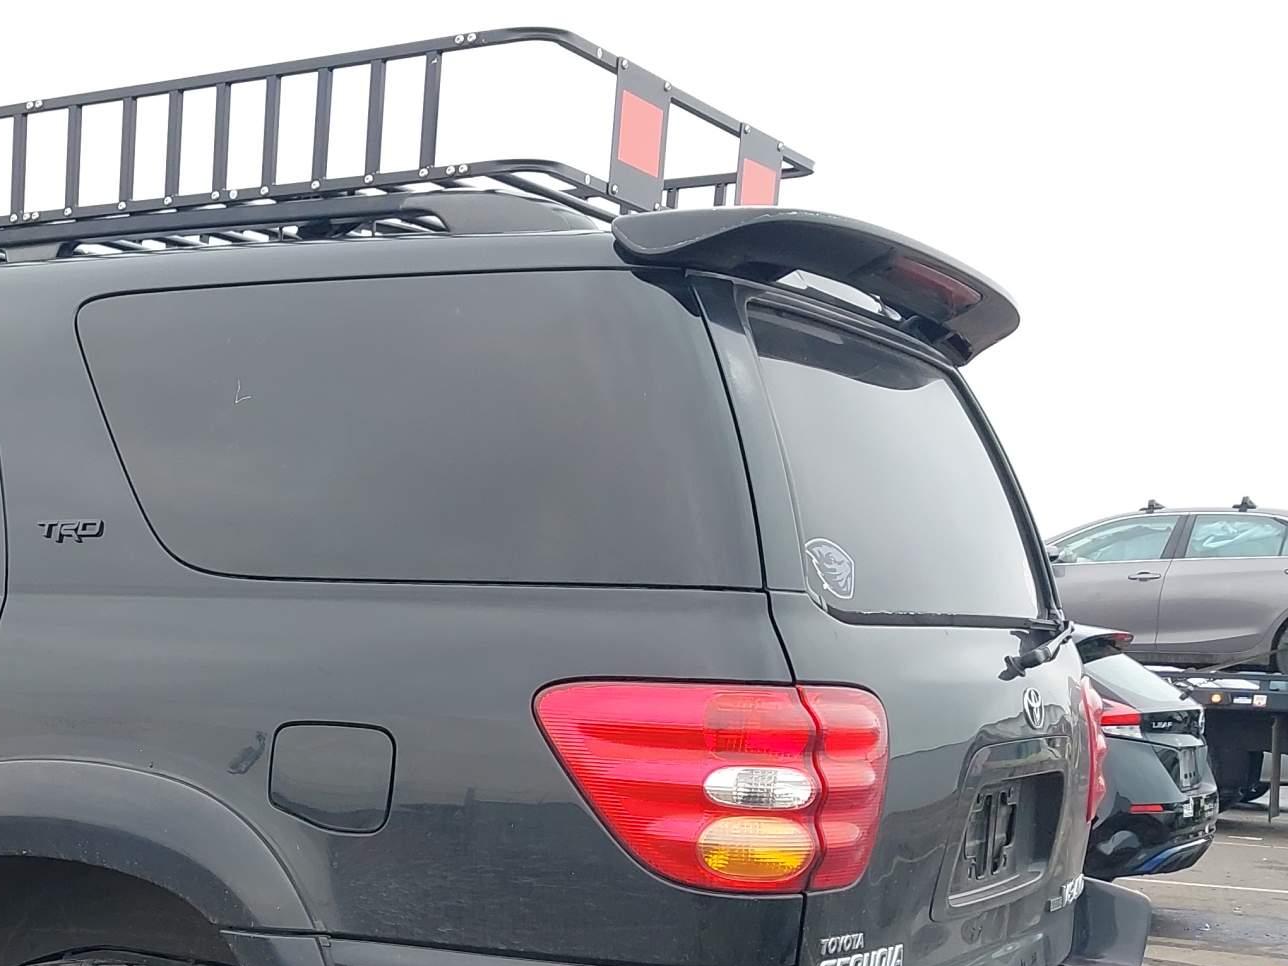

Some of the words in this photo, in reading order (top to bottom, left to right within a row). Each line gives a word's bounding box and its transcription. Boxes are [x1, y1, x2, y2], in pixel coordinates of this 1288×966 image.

[37, 519, 105, 544] TRD
[1152, 721, 1173, 729] LEAF
[820, 932, 865, 956] TOYOTA
